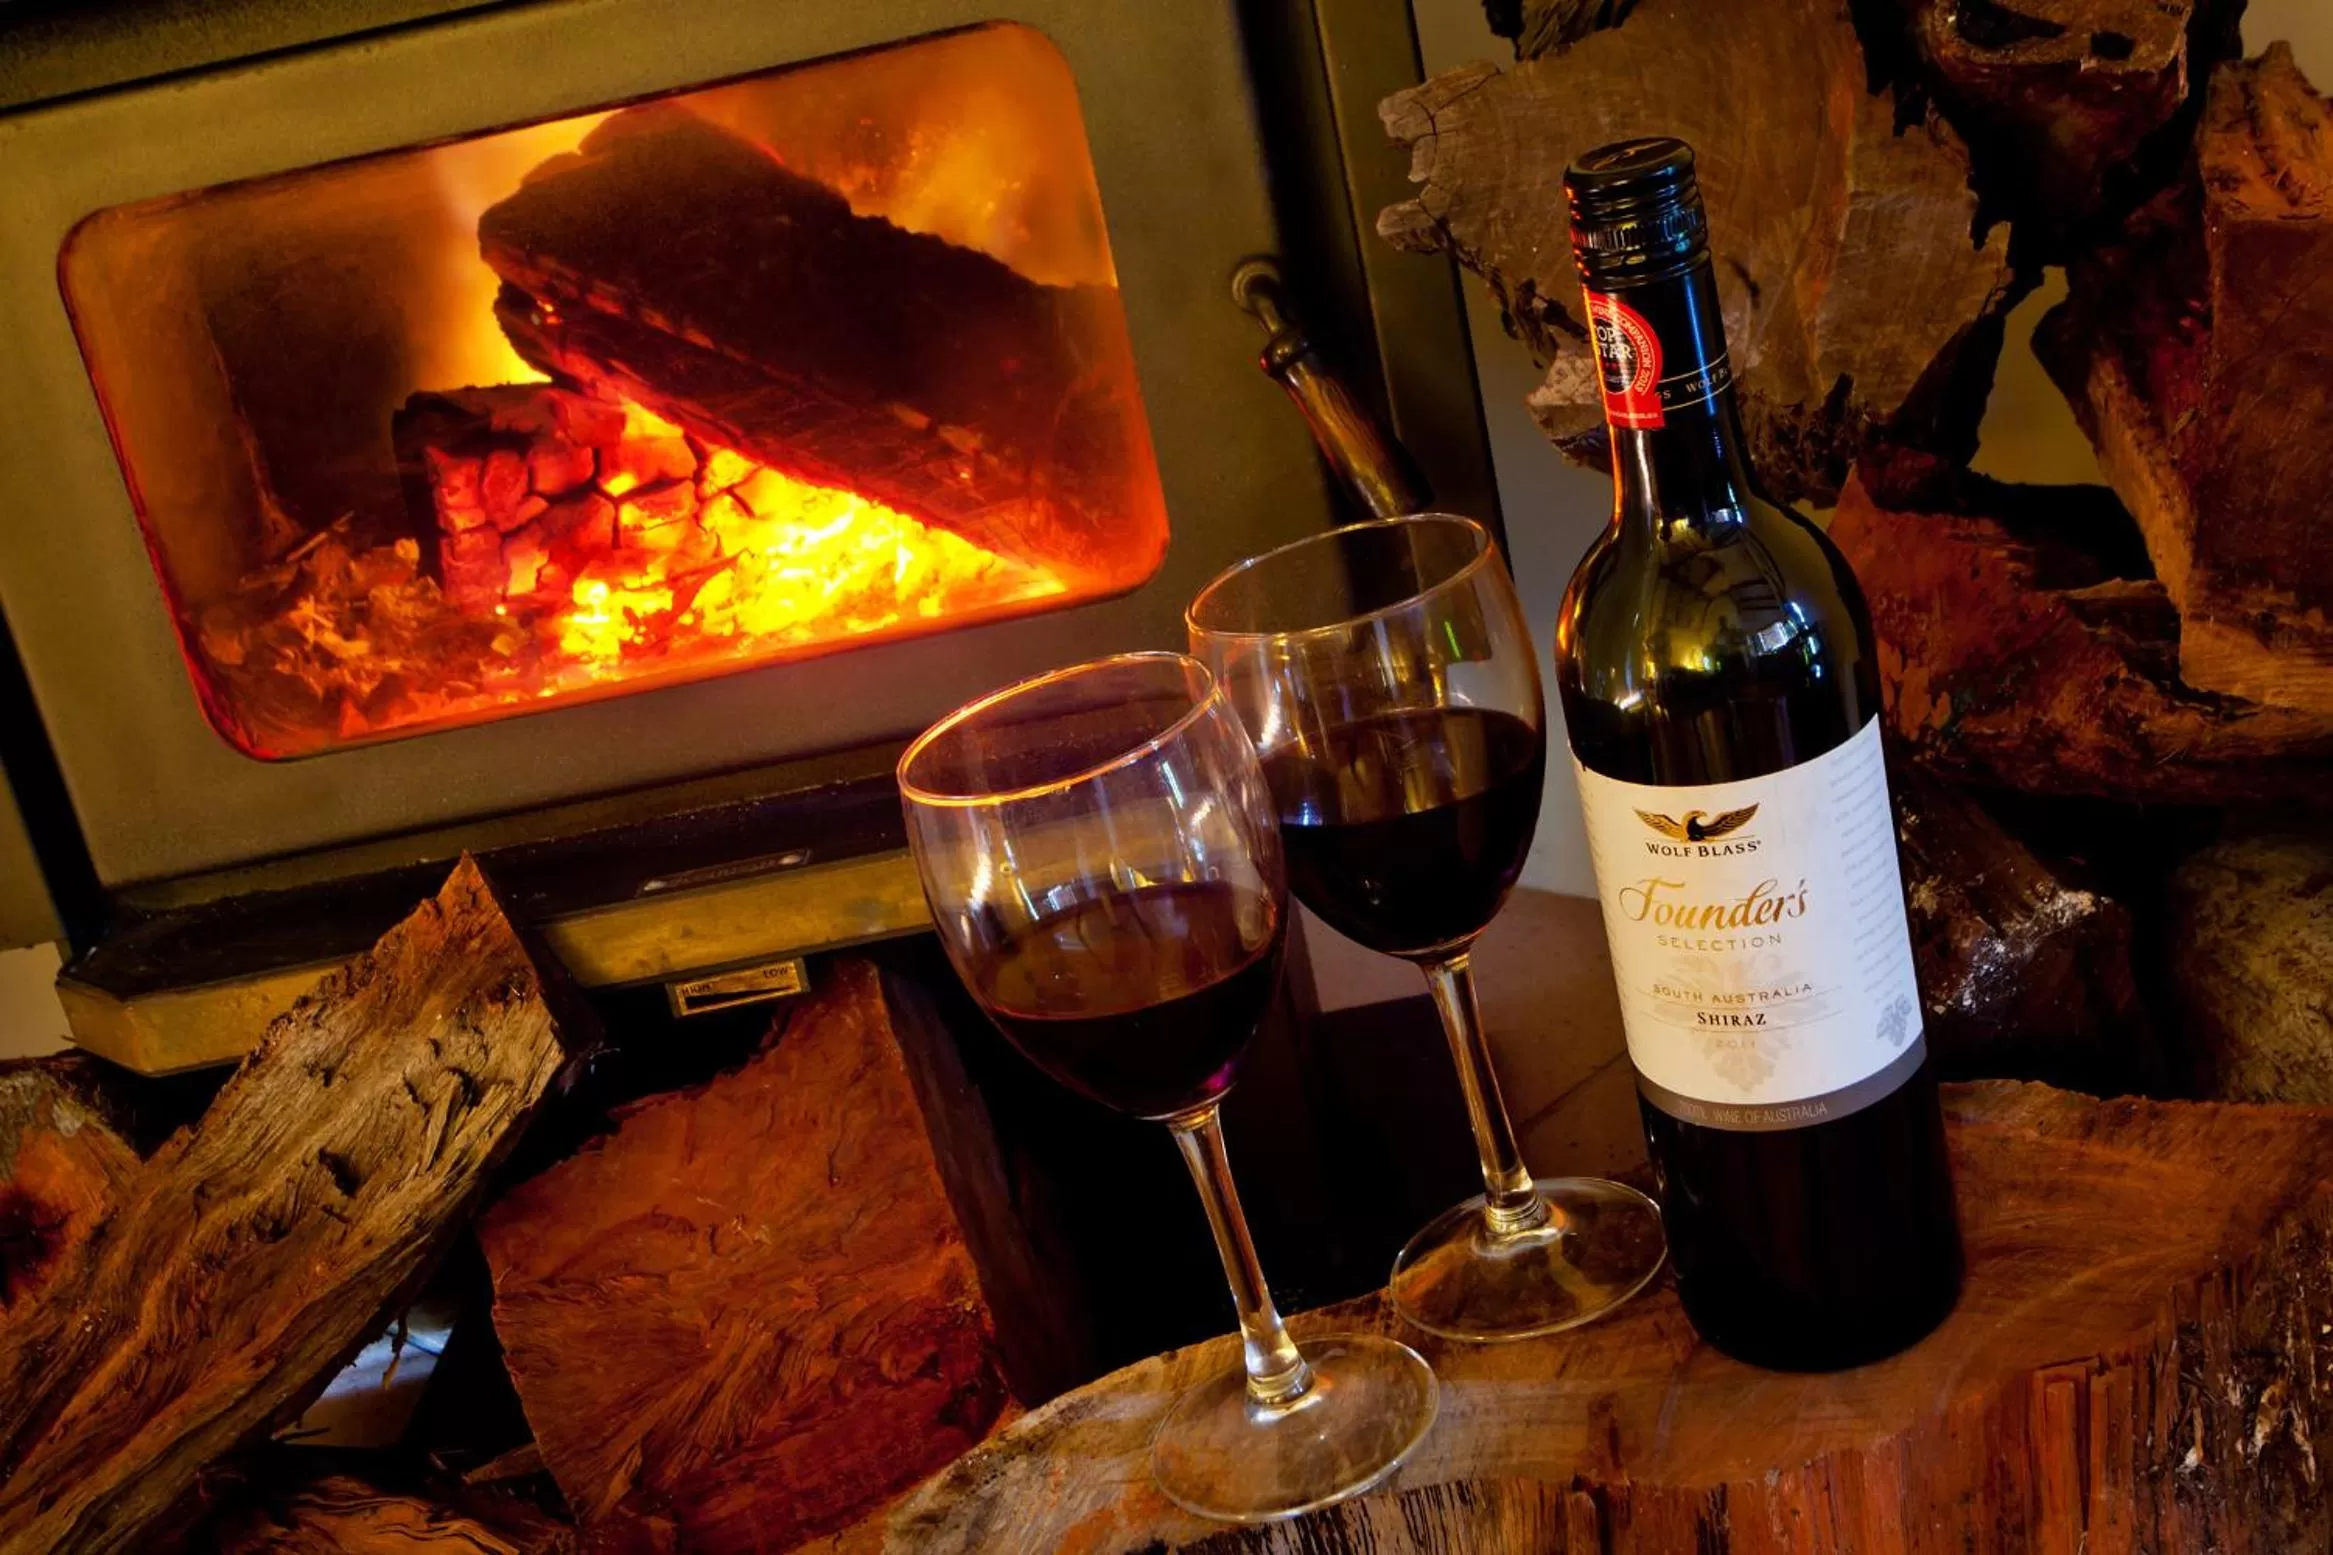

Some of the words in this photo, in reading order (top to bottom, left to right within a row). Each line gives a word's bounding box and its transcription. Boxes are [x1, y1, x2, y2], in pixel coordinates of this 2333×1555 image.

[1645, 842, 1693, 857] WOLF
[1698, 840, 1759, 858] BLASS
[1618, 876, 1809, 931] Founder's
[1656, 933, 1782, 951] SELECTION
[763, 967, 788, 978] LOW
[1652, 984, 1703, 1001] SOUTH
[1711, 983, 1813, 1004] AUSTRALIA
[1697, 1011, 1767, 1026] SHIRAZ
[1713, 1108, 1741, 1124] WINE
[1744, 1110, 1761, 1124] OF
[1763, 1101, 1828, 1122] AUSTRALIA
